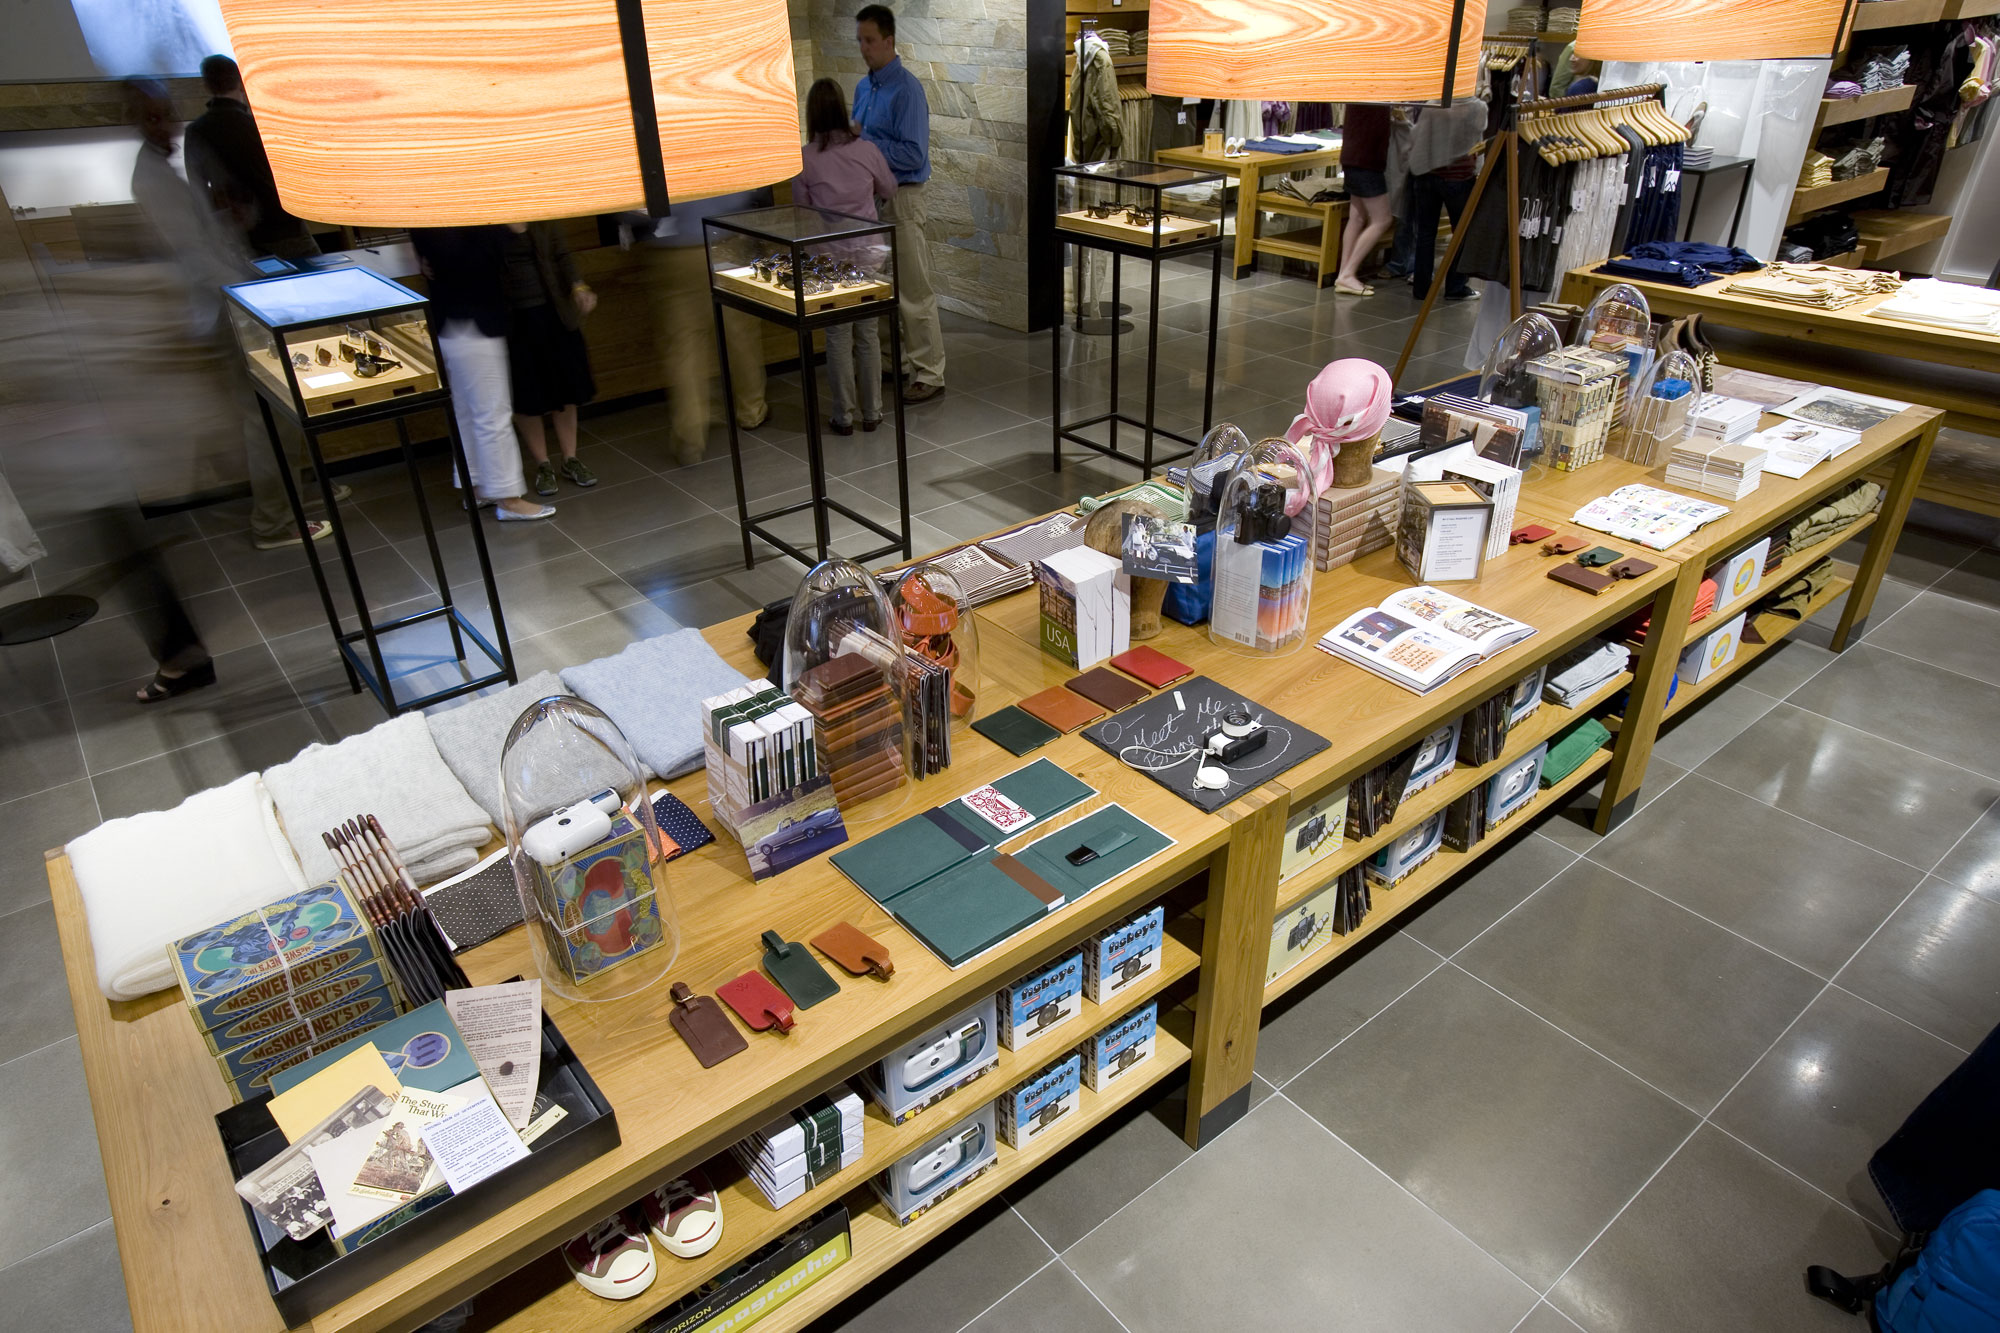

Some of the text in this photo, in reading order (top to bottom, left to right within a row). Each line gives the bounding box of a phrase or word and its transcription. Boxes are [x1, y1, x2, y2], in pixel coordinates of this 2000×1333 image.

[1046, 624, 1070, 654] USA
[1134, 697, 1228, 754] Meet Me
[1108, 918, 1158, 954] fisheye
[336, 951, 349, 966] 19
[346, 978, 360, 992] 19
[1021, 964, 1076, 1000] fisheye
[357, 1002, 371, 1016] 19
[1105, 1012, 1152, 1046] fisheye
[1024, 1066, 1074, 1104] fisheye
[400, 1096, 448, 1111] The Stuff
[408, 1105, 430, 1116] That
[705, 1305, 725, 1320] camera
[725, 1294, 740, 1306] from
[740, 1284, 758, 1297] Russia
[758, 1278, 765, 1286] by
